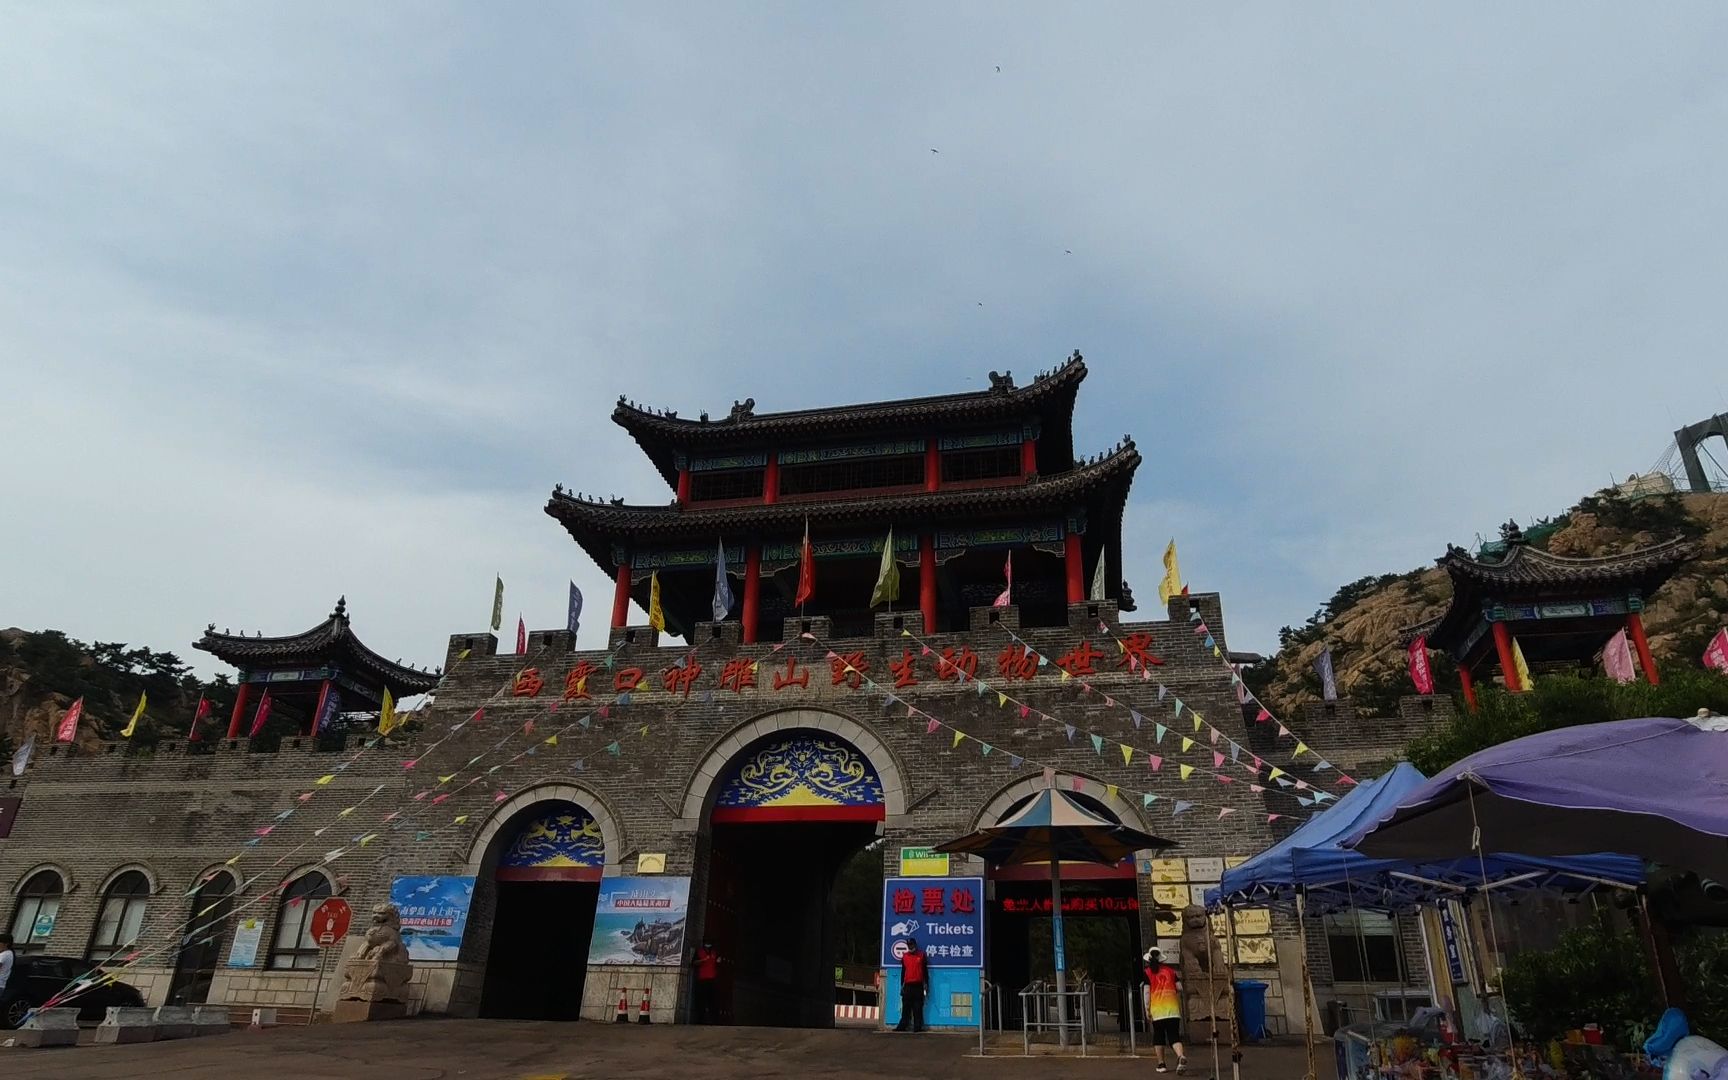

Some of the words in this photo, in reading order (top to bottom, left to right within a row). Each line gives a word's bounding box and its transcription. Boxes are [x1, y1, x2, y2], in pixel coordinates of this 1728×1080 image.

[511, 632, 1164, 702] 西霞口神雕山野生动物世界
[893, 887, 975, 914] 检票处
[926, 922, 974, 935] Tickets
[926, 945, 973, 957] 停车检查
